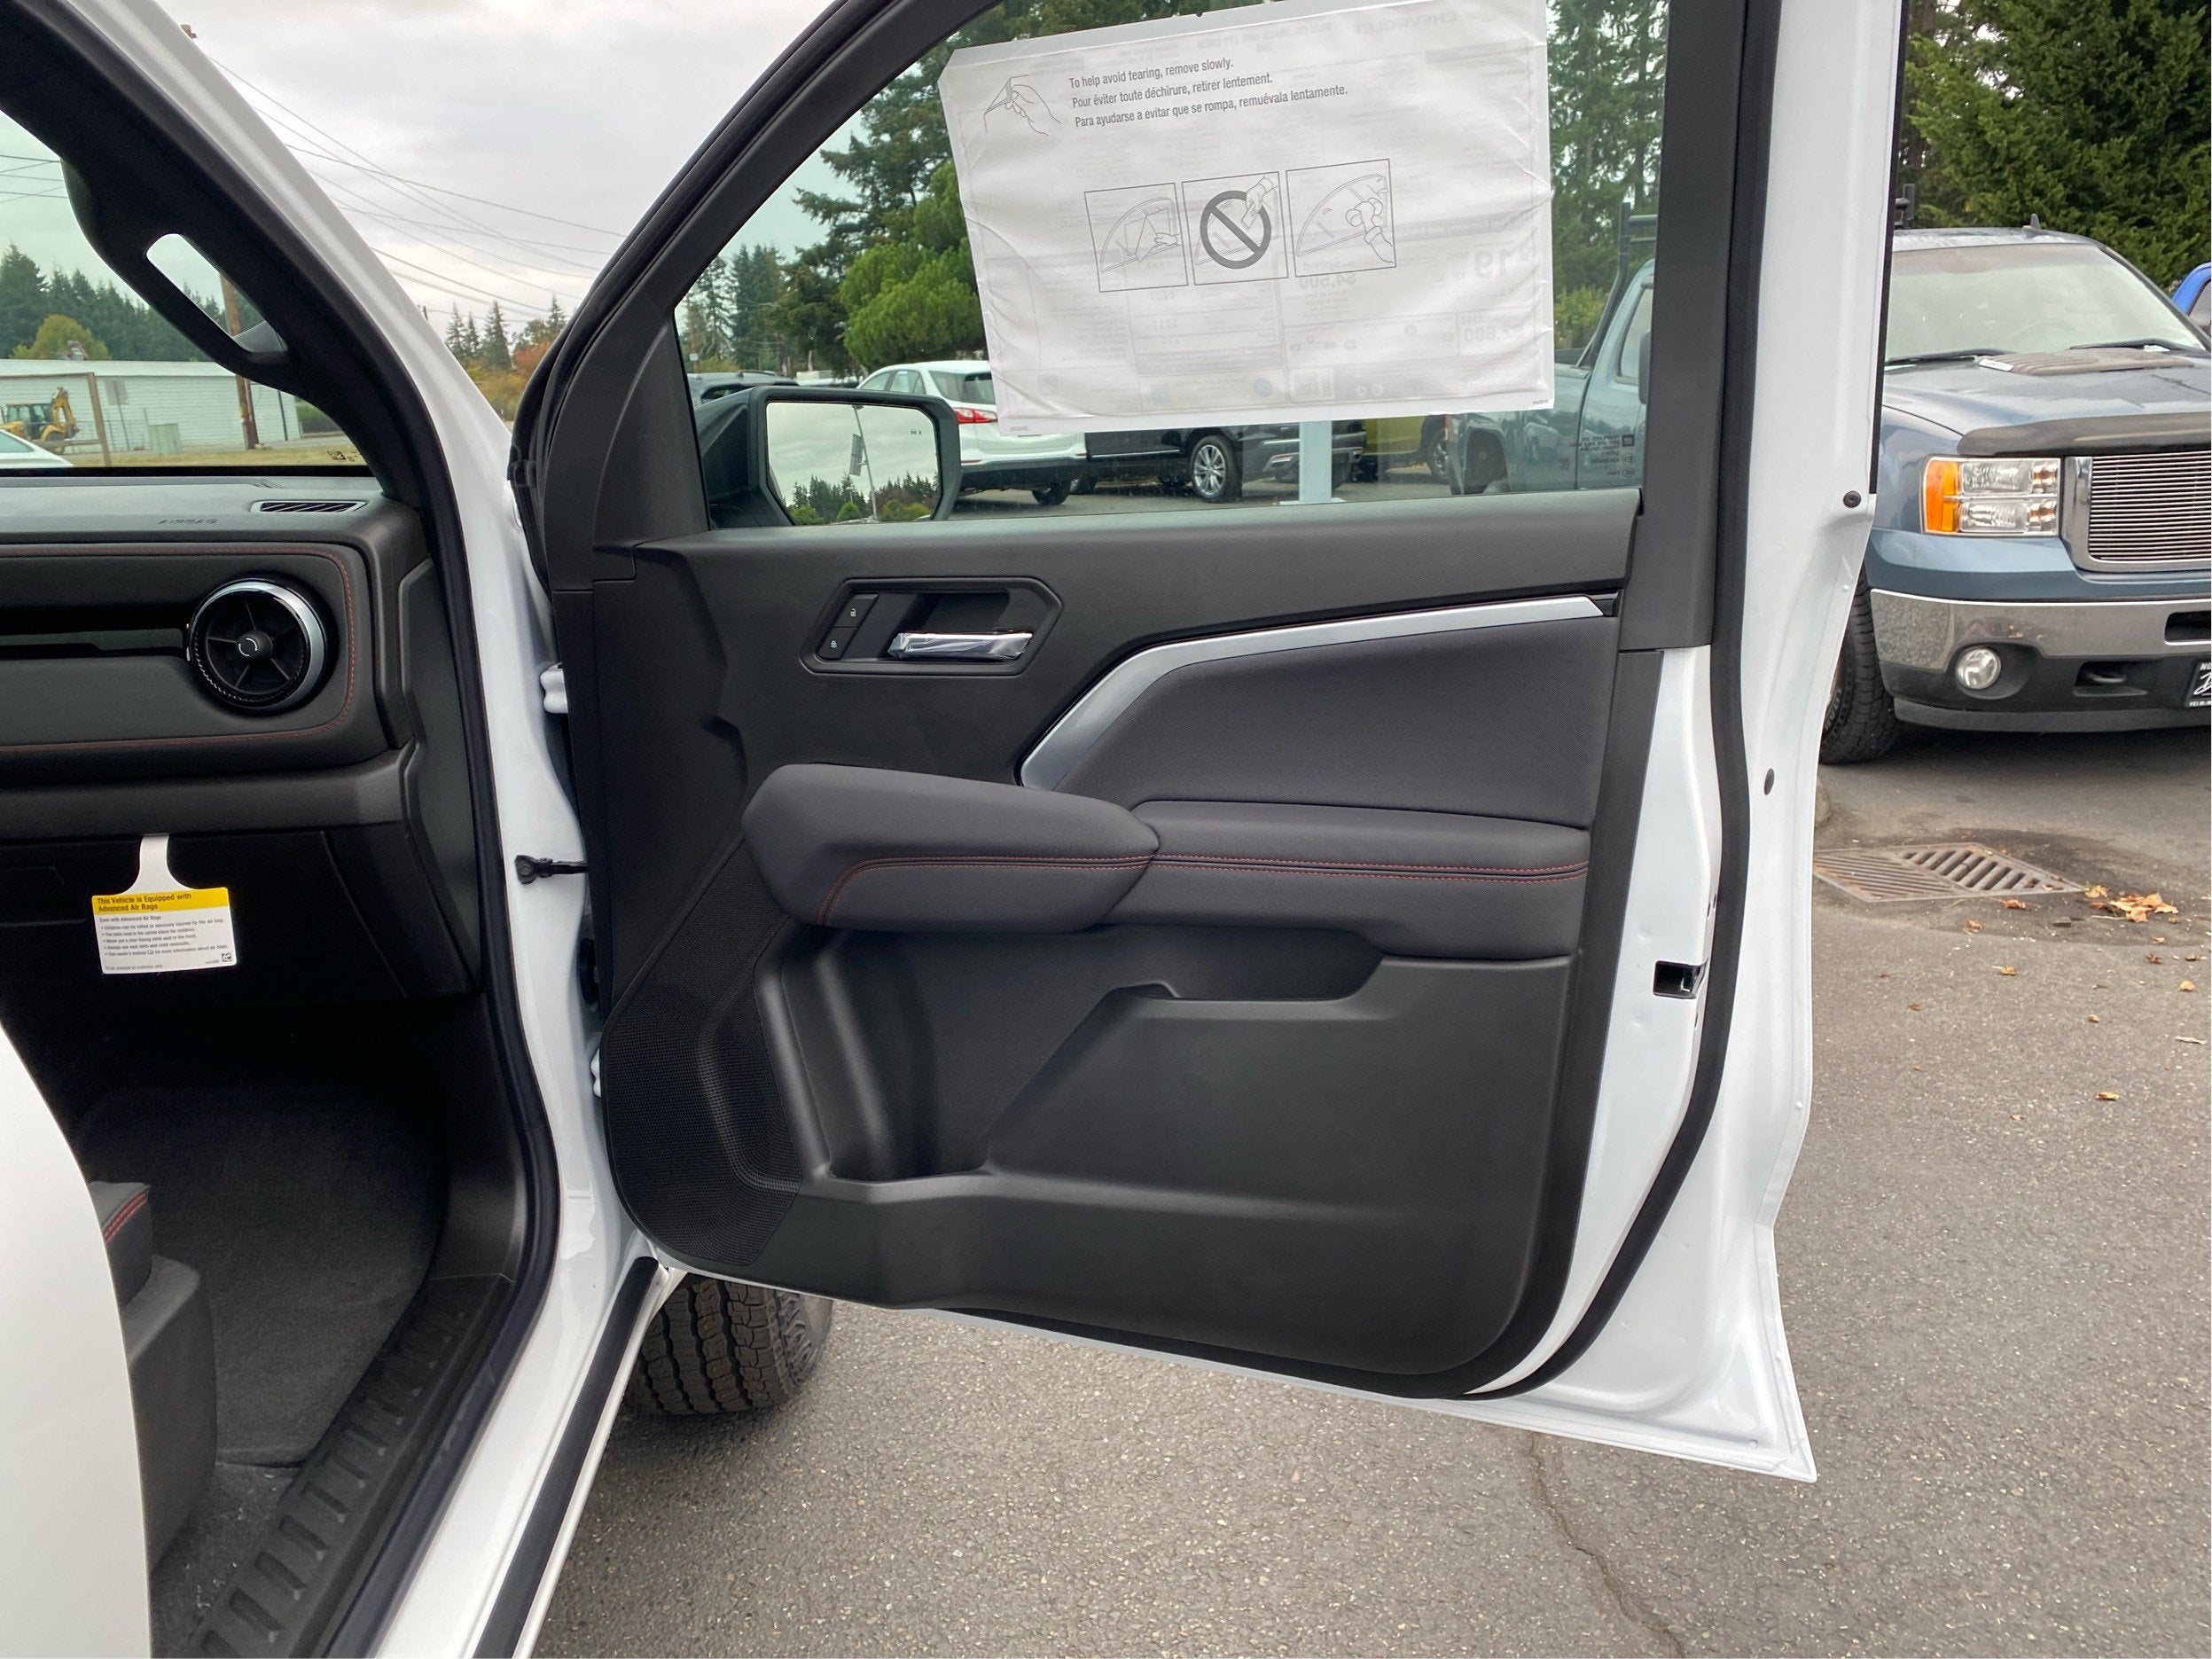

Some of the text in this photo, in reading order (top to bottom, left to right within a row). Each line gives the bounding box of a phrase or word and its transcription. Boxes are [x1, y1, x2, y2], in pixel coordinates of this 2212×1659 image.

[1069, 58, 1233, 88] To help avoid tearing, remove slowly.
[1073, 73, 1272, 107] Pour éviter toute déchirure, retirer lentement.
[1075, 85, 1348, 127] Para ayudarse a evitar que se rompa, remuévala lentamente.
[144, 895, 175, 904] Equipped
